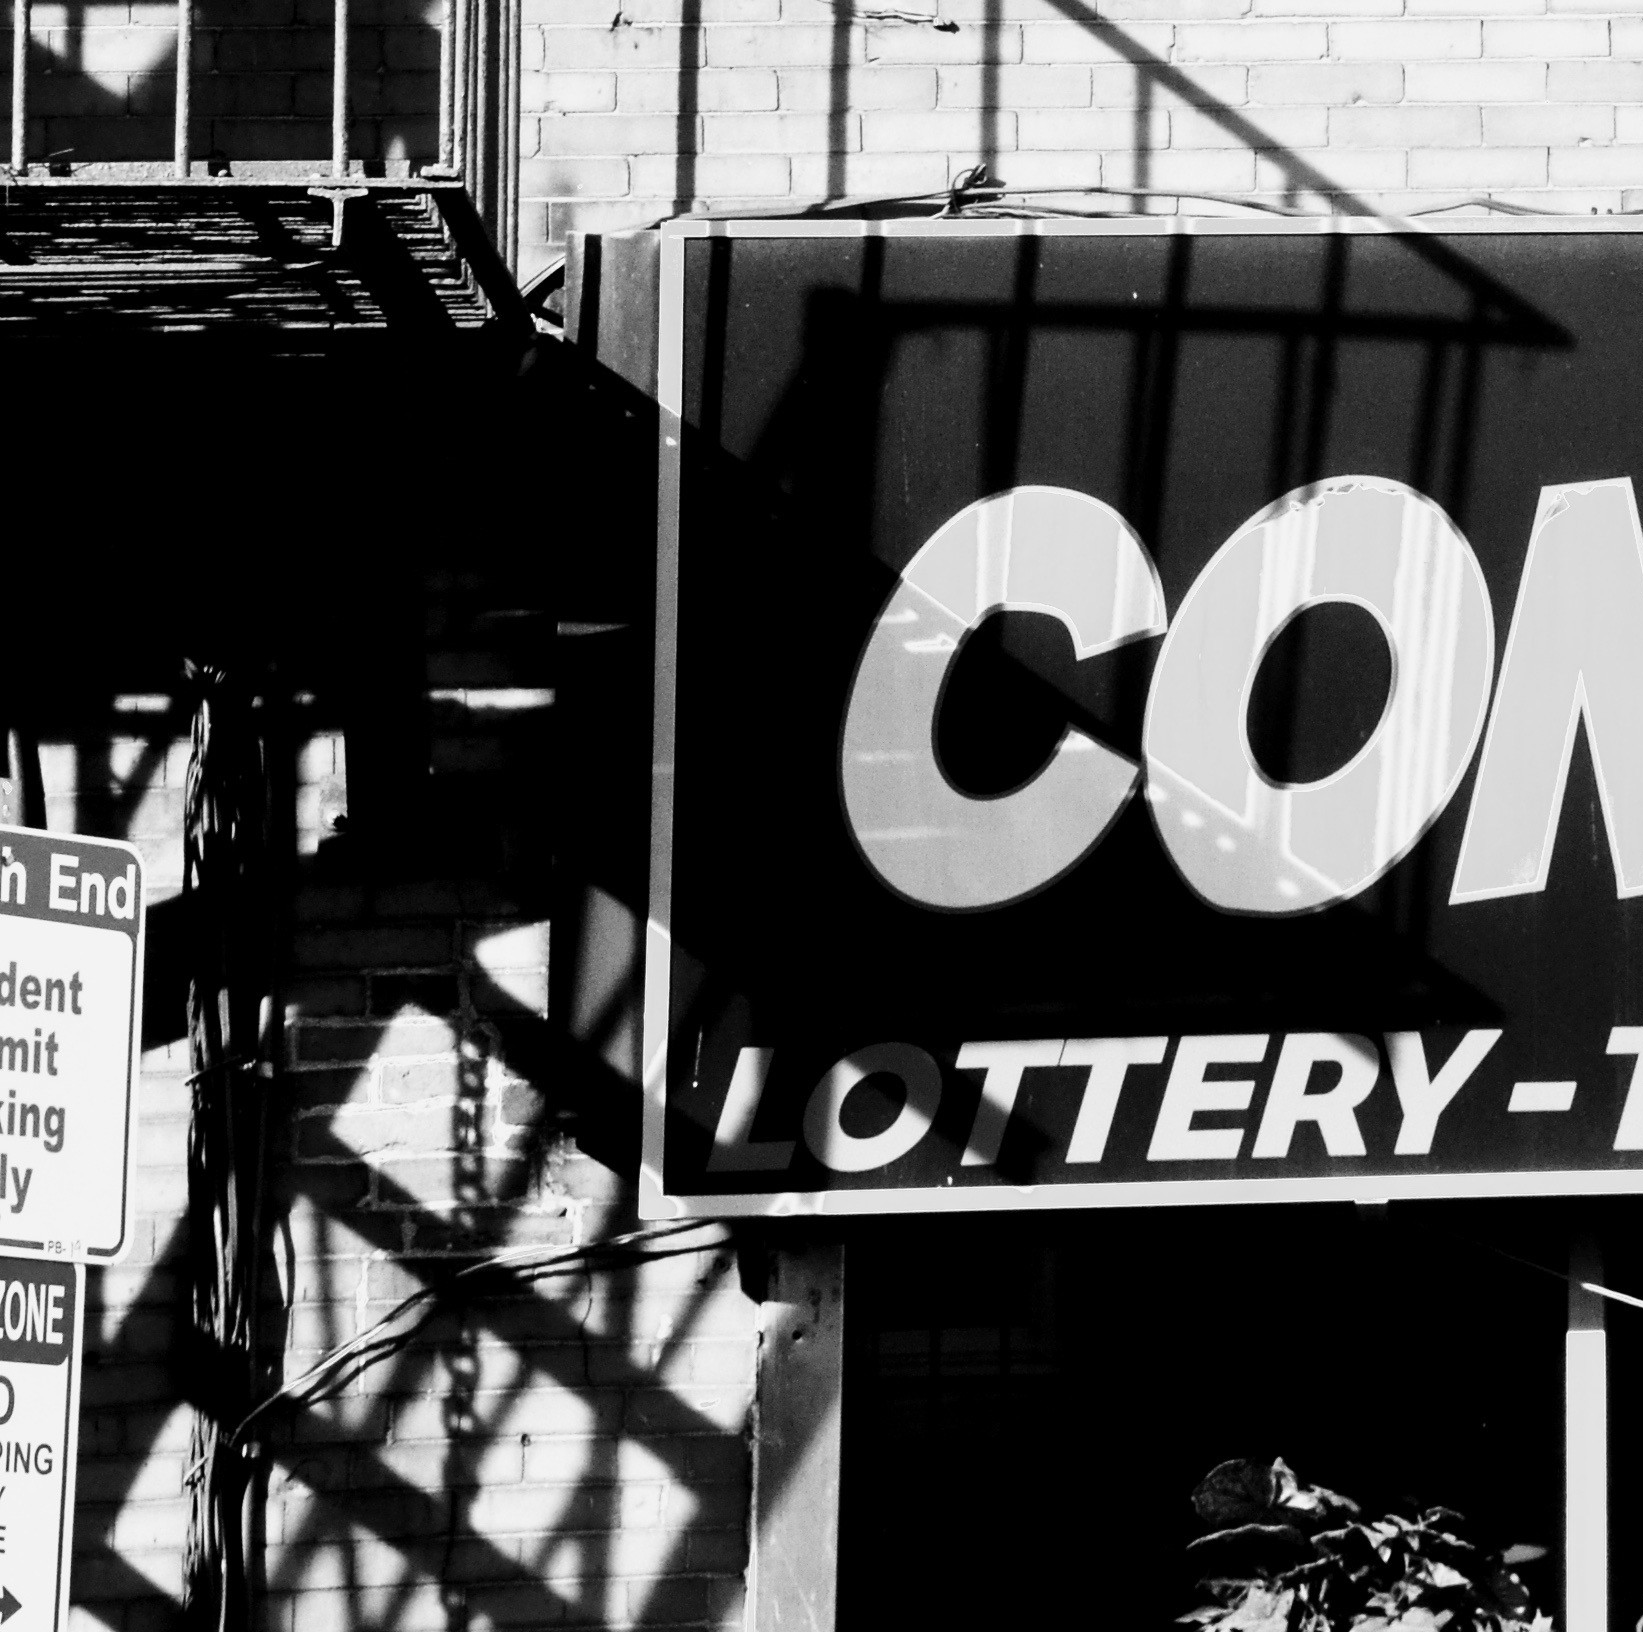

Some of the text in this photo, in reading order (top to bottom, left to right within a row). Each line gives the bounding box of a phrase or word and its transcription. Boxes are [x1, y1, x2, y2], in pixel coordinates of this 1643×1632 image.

[49, 853, 136, 920] End
[705, 1028, 1502, 1172] LOTTERY
[0, 1440, 54, 1476] ING
